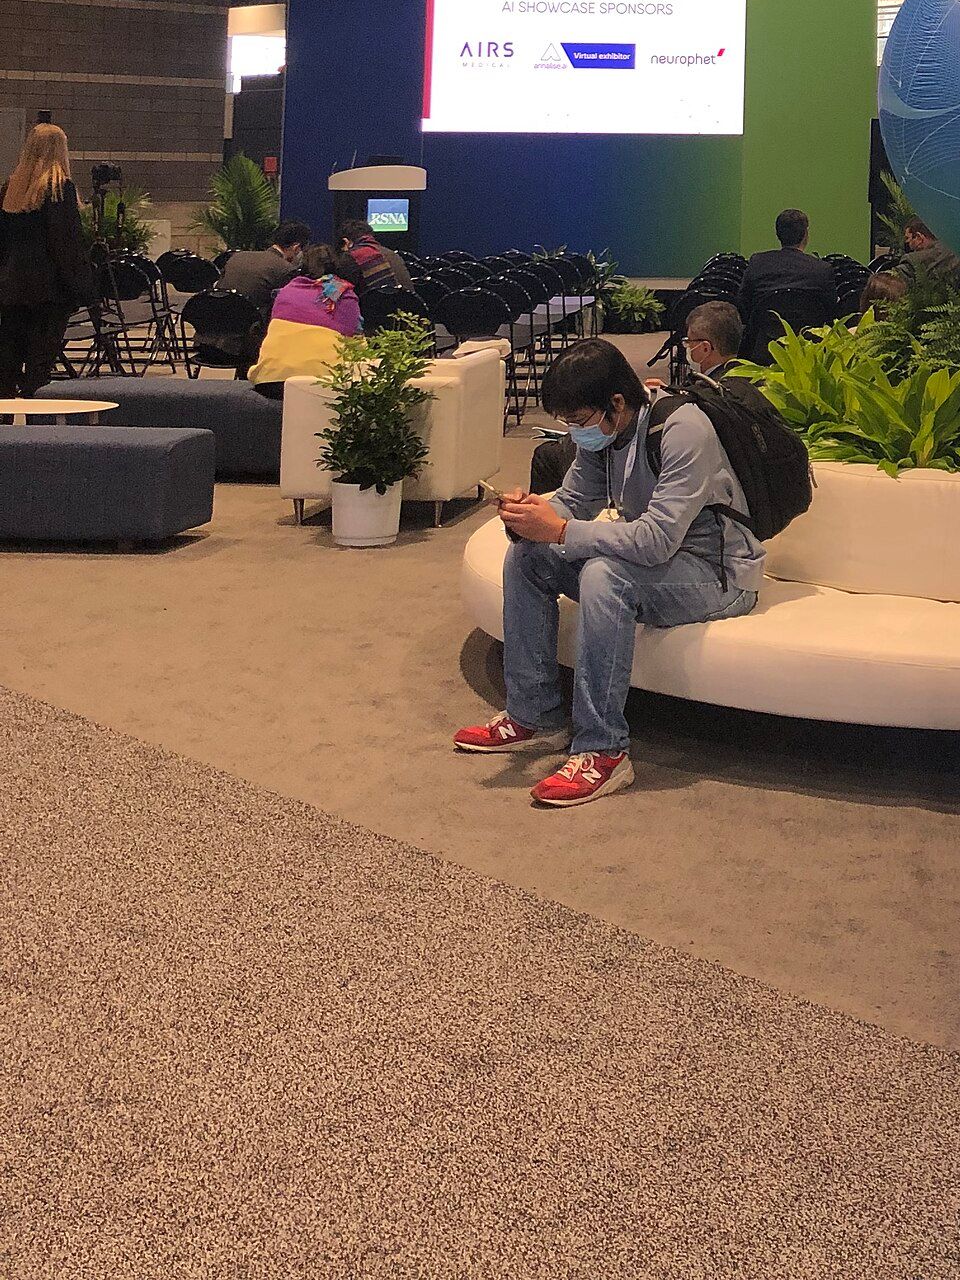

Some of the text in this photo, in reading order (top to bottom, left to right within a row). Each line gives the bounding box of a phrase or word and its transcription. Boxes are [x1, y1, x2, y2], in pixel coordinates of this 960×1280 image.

[502, 1, 673, 15] AI SHOWCASE SPONSORS
[460, 42, 514, 57] AIRS
[651, 53, 716, 66] neurophet
[368, 212, 407, 225] RSNA
[498, 723, 517, 739] N
